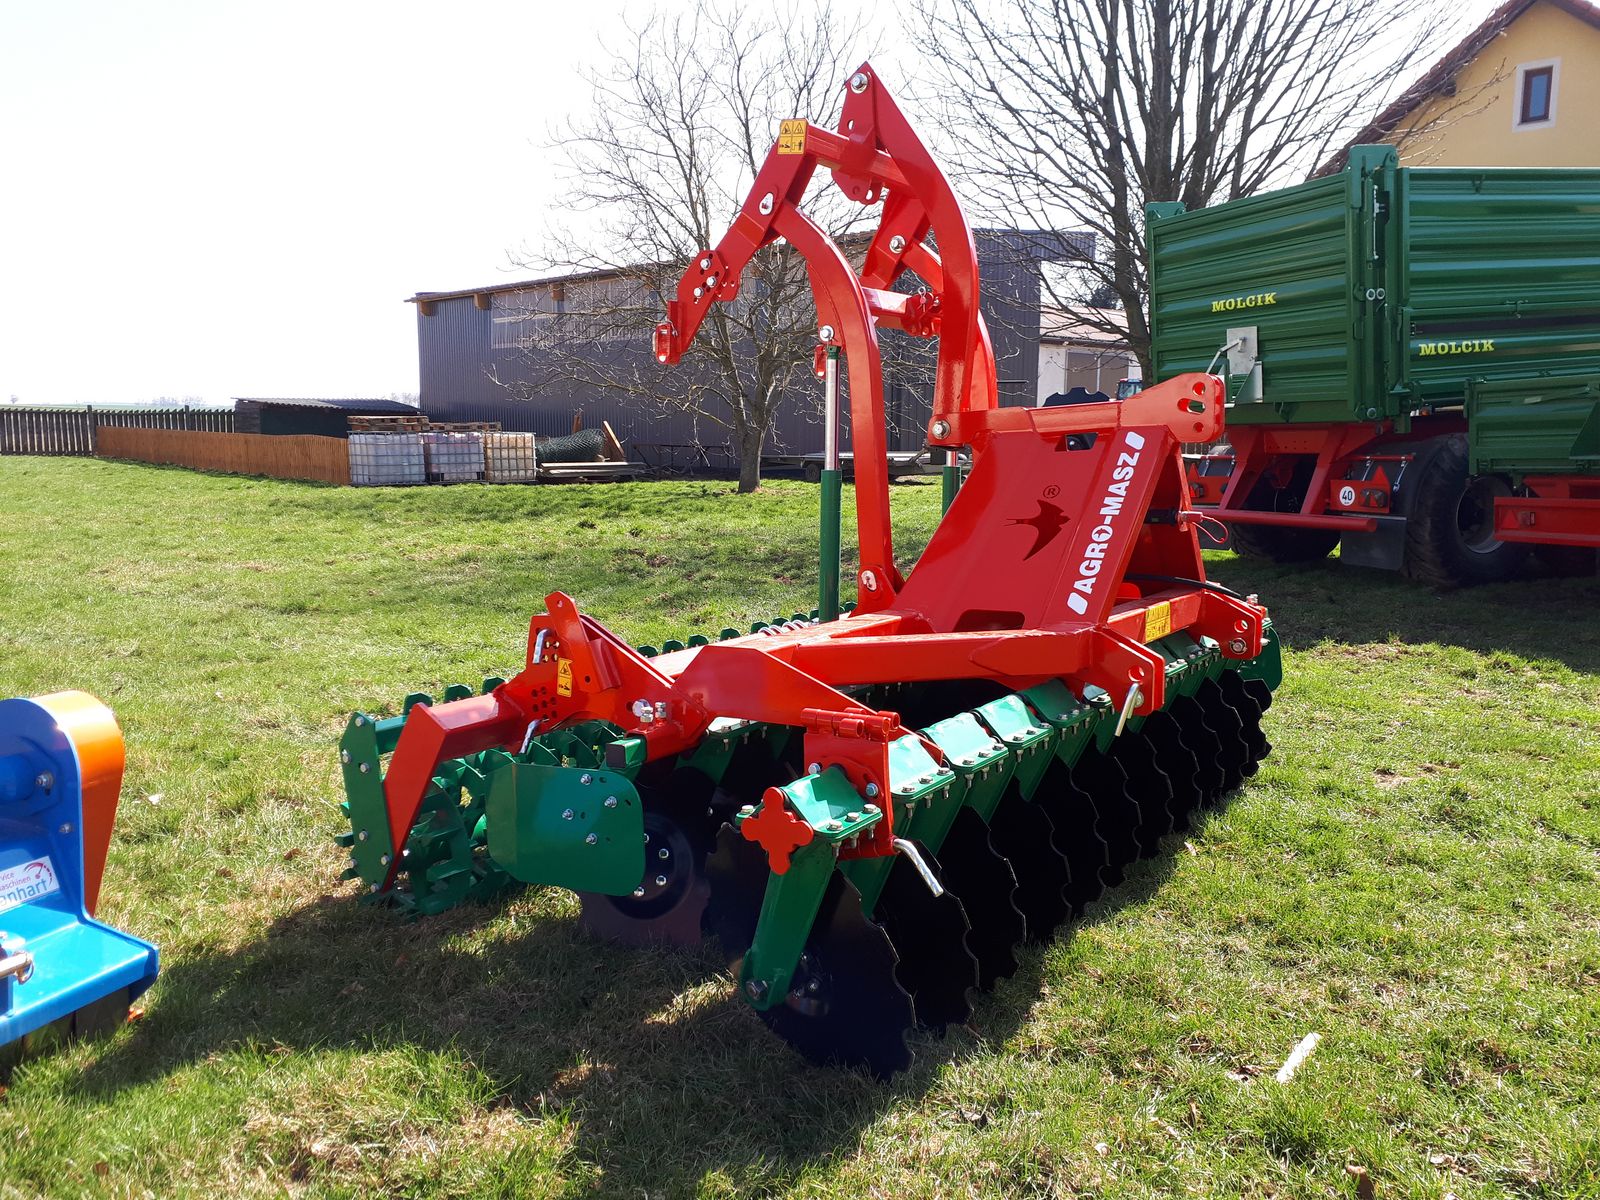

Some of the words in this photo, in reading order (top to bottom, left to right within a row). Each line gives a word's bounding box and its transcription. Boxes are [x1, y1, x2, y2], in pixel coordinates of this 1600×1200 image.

[1211, 292, 1277, 312] MOLCIK
[1418, 339, 1495, 356] MOLCIK
[1342, 490, 1353, 501] 40
[1073, 452, 1141, 595] AGRO-MASZ
[0, 876, 31, 891] aschinen
